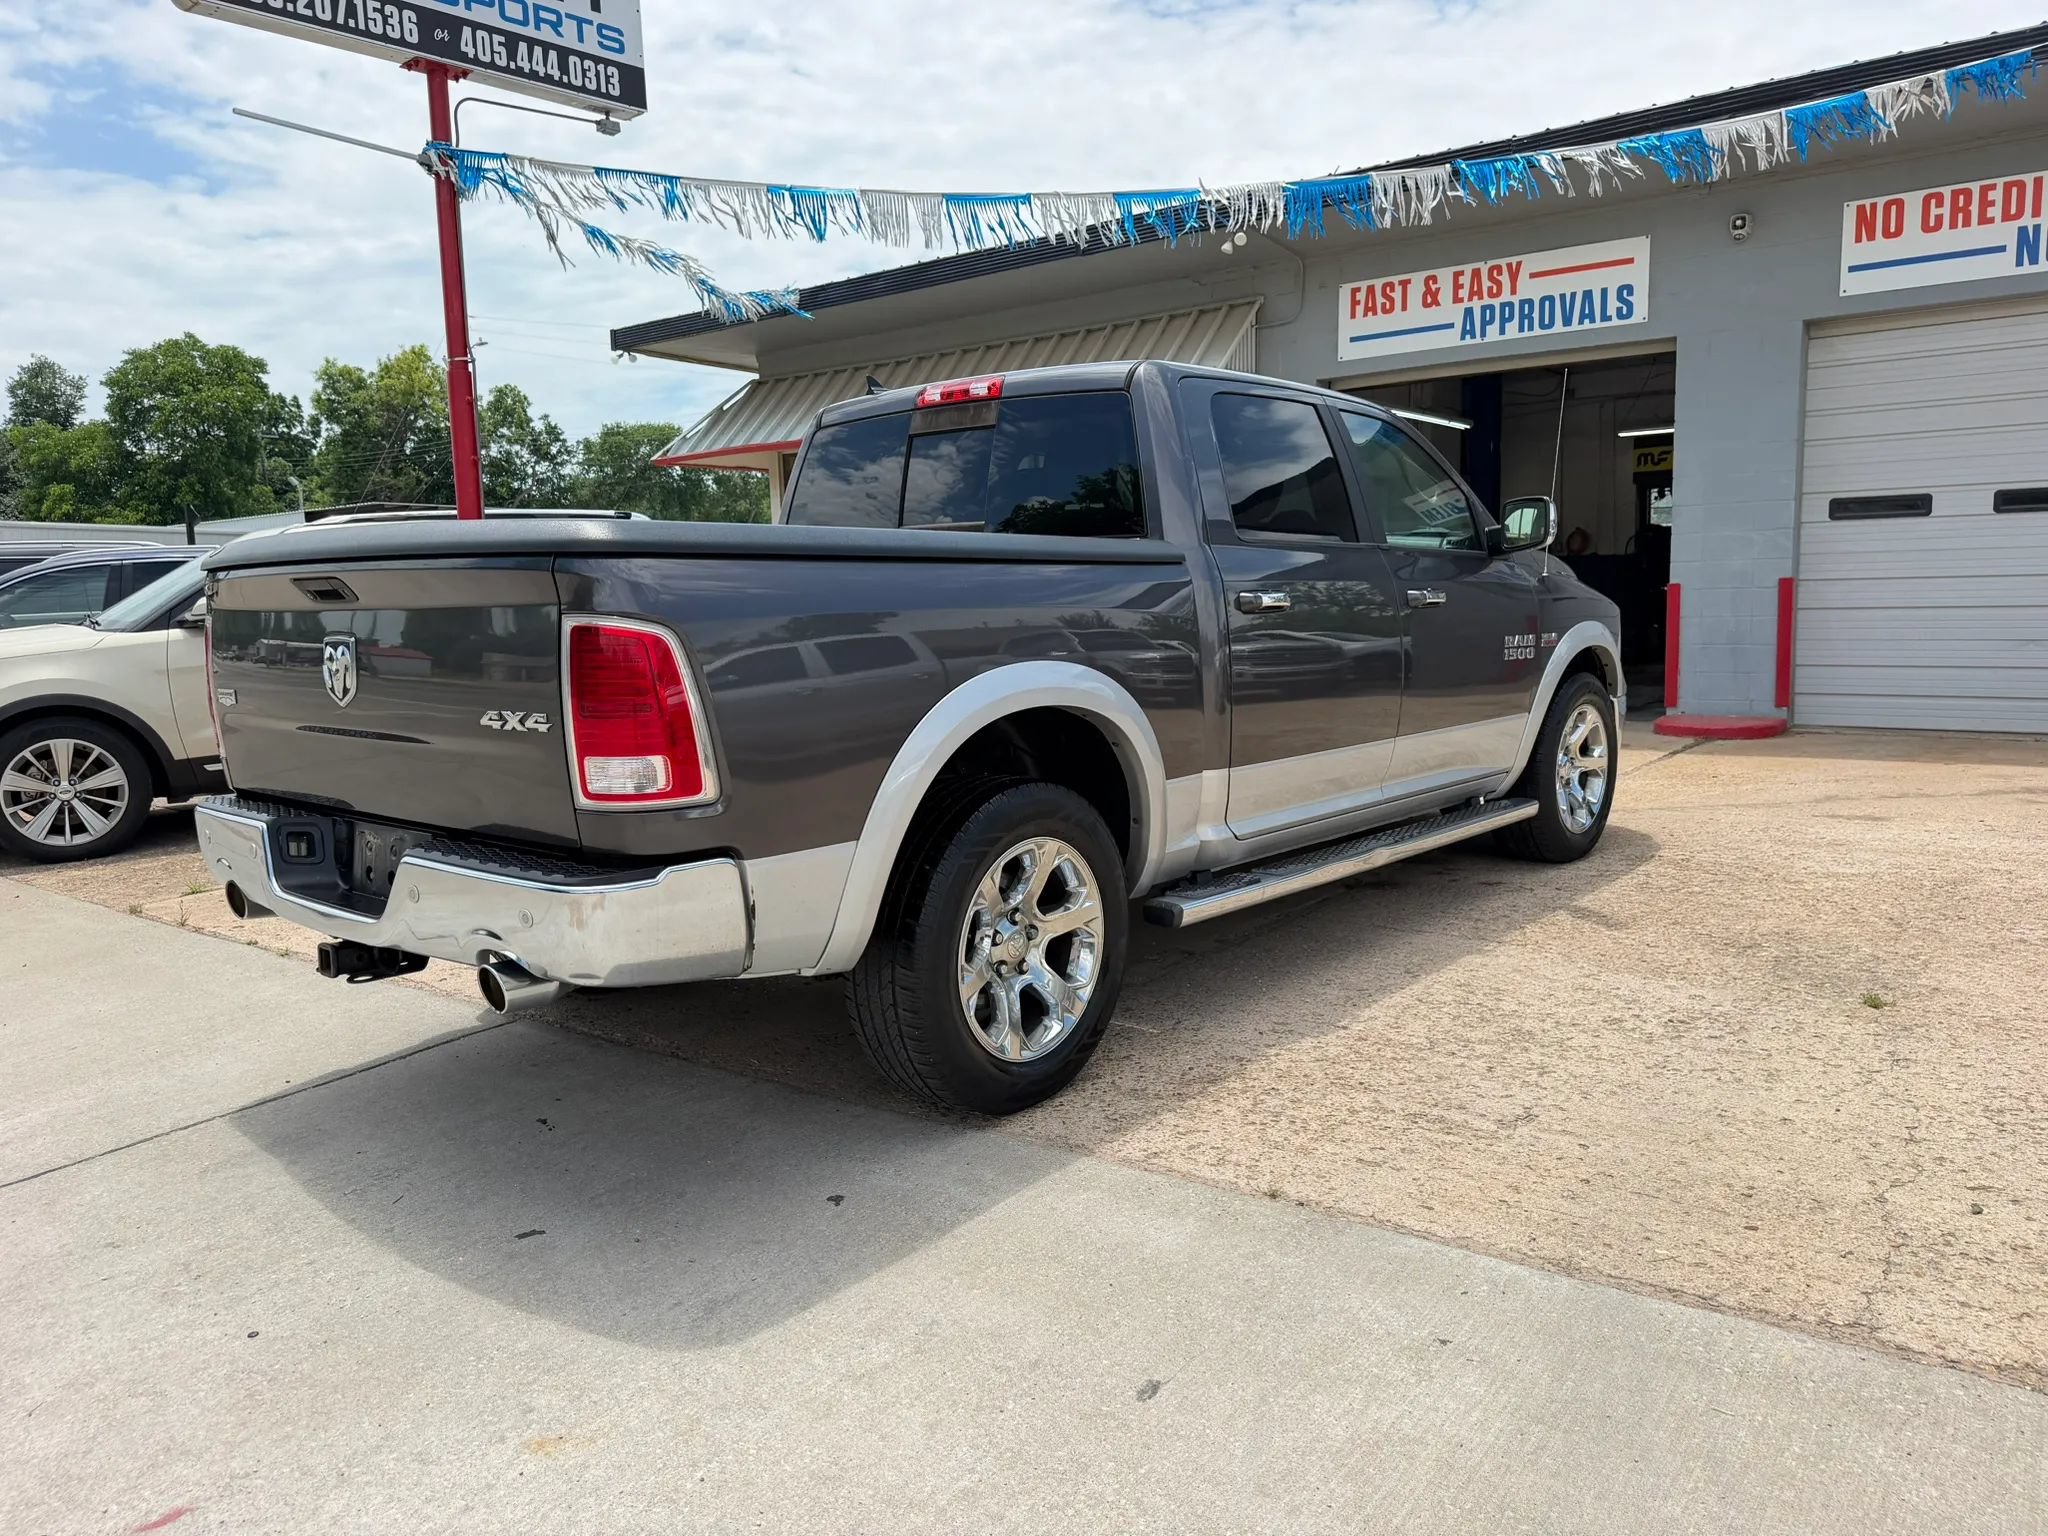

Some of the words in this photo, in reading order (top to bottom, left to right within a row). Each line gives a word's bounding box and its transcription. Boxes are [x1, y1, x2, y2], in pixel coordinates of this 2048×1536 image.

[431, 0, 626, 55] ORTS
[433, 27, 450, 42] or
[460, 25, 621, 97] 405.444.0313
[1854, 197, 1905, 244] NO
[1920, 175, 2044, 234] CREDI
[2015, 223, 2048, 268] N
[1350, 278, 1412, 320] FAST
[1422, 274, 1441, 308] &
[1452, 260, 1523, 305] EASY
[1460, 283, 1634, 341] APPROVALS
[1503, 633, 1536, 648] RAM
[1503, 646, 1535, 661] 1500
